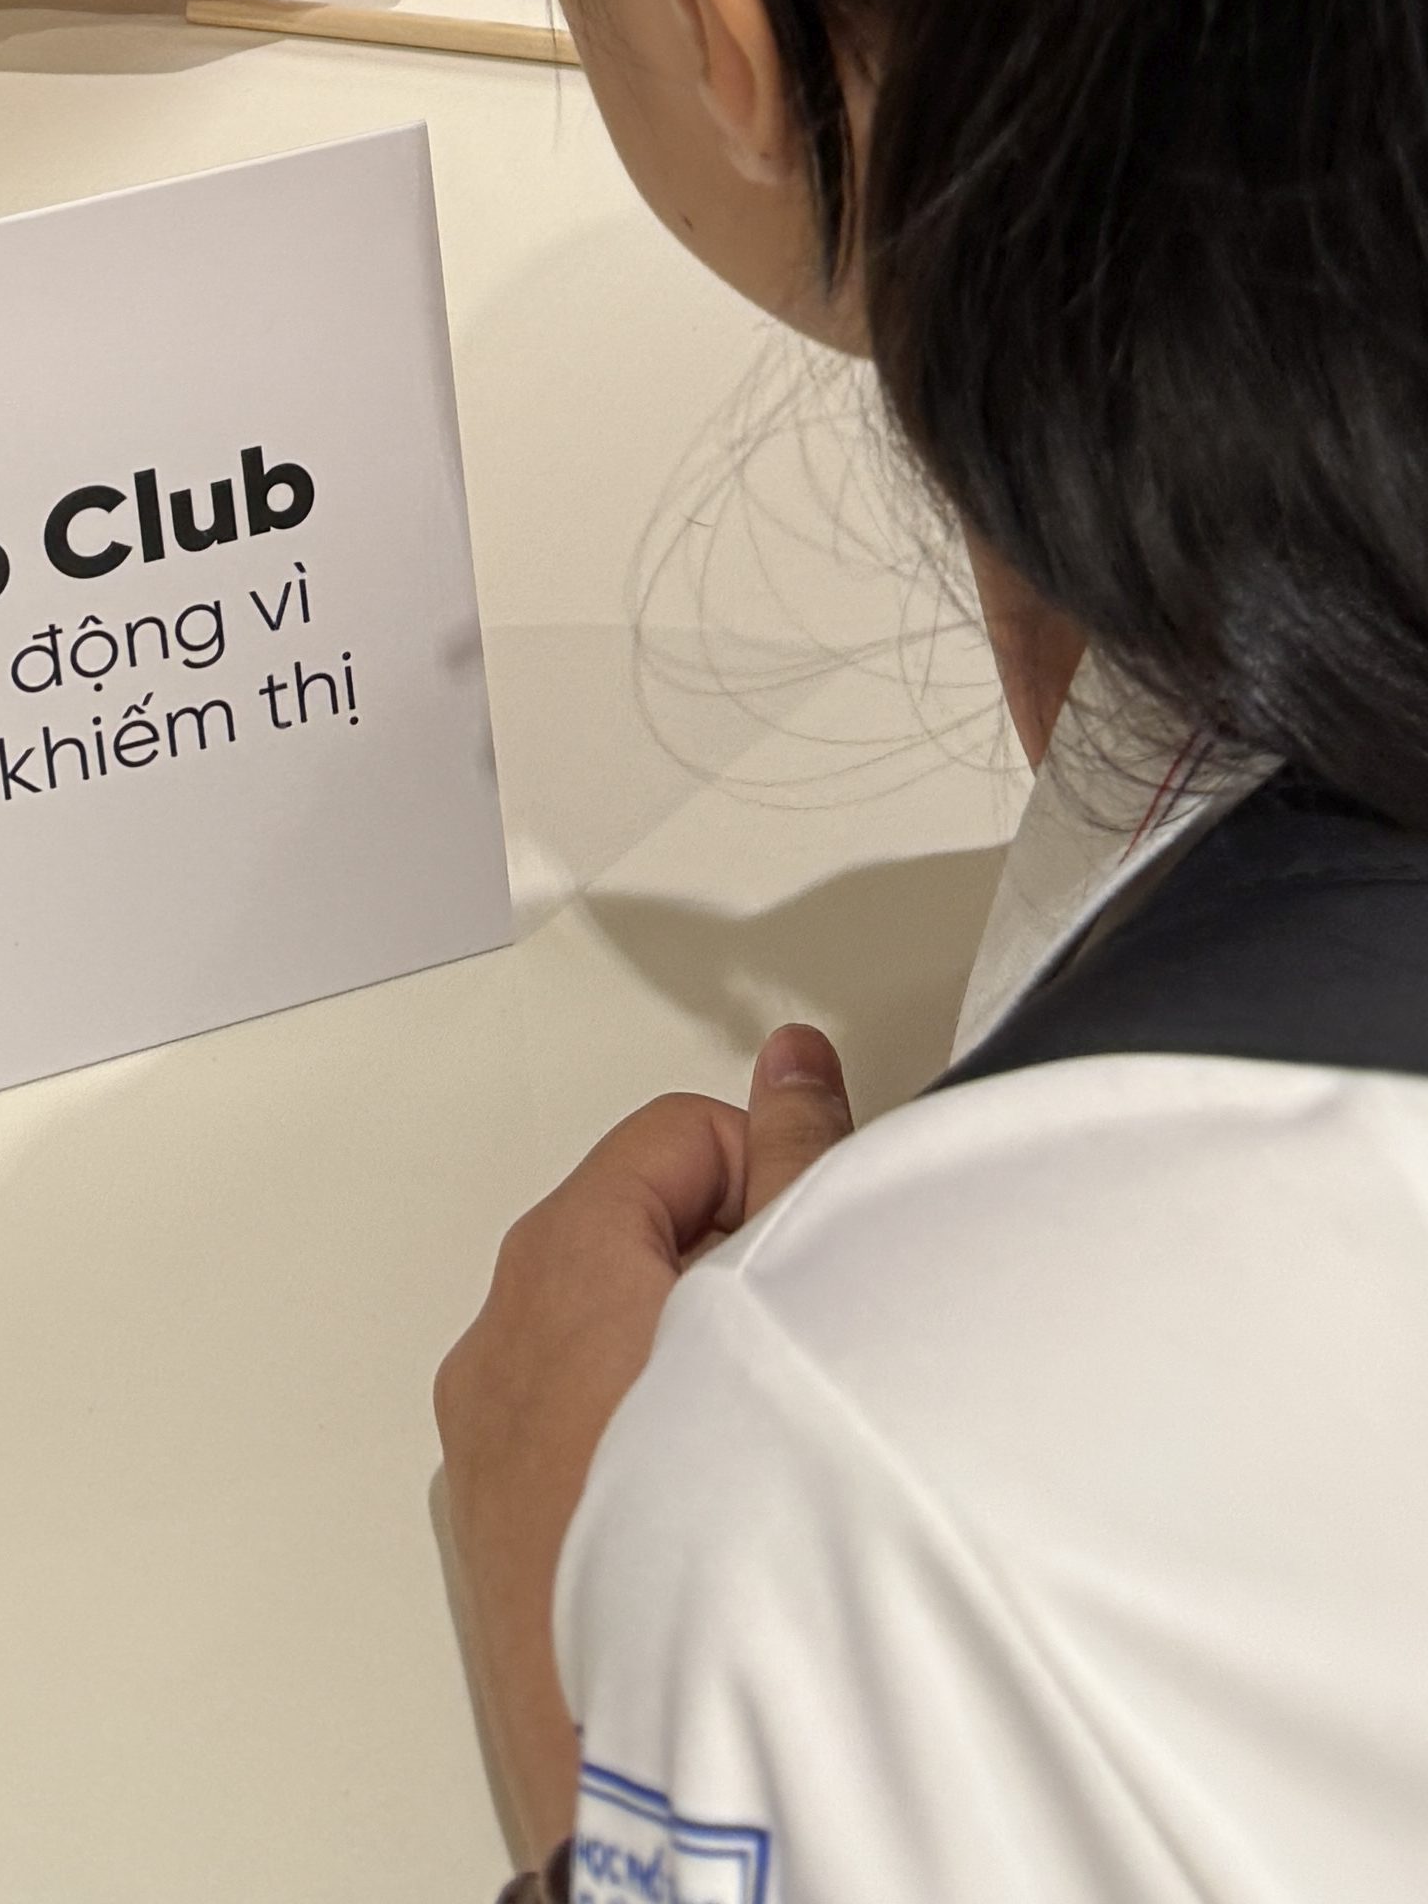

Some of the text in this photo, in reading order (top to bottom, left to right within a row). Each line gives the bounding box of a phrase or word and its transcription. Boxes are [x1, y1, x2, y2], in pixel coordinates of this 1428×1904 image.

[44, 446, 314, 579] Club
[11, 600, 225, 693] động
[250, 562, 311, 631] vì
[259, 652, 358, 729] thị
